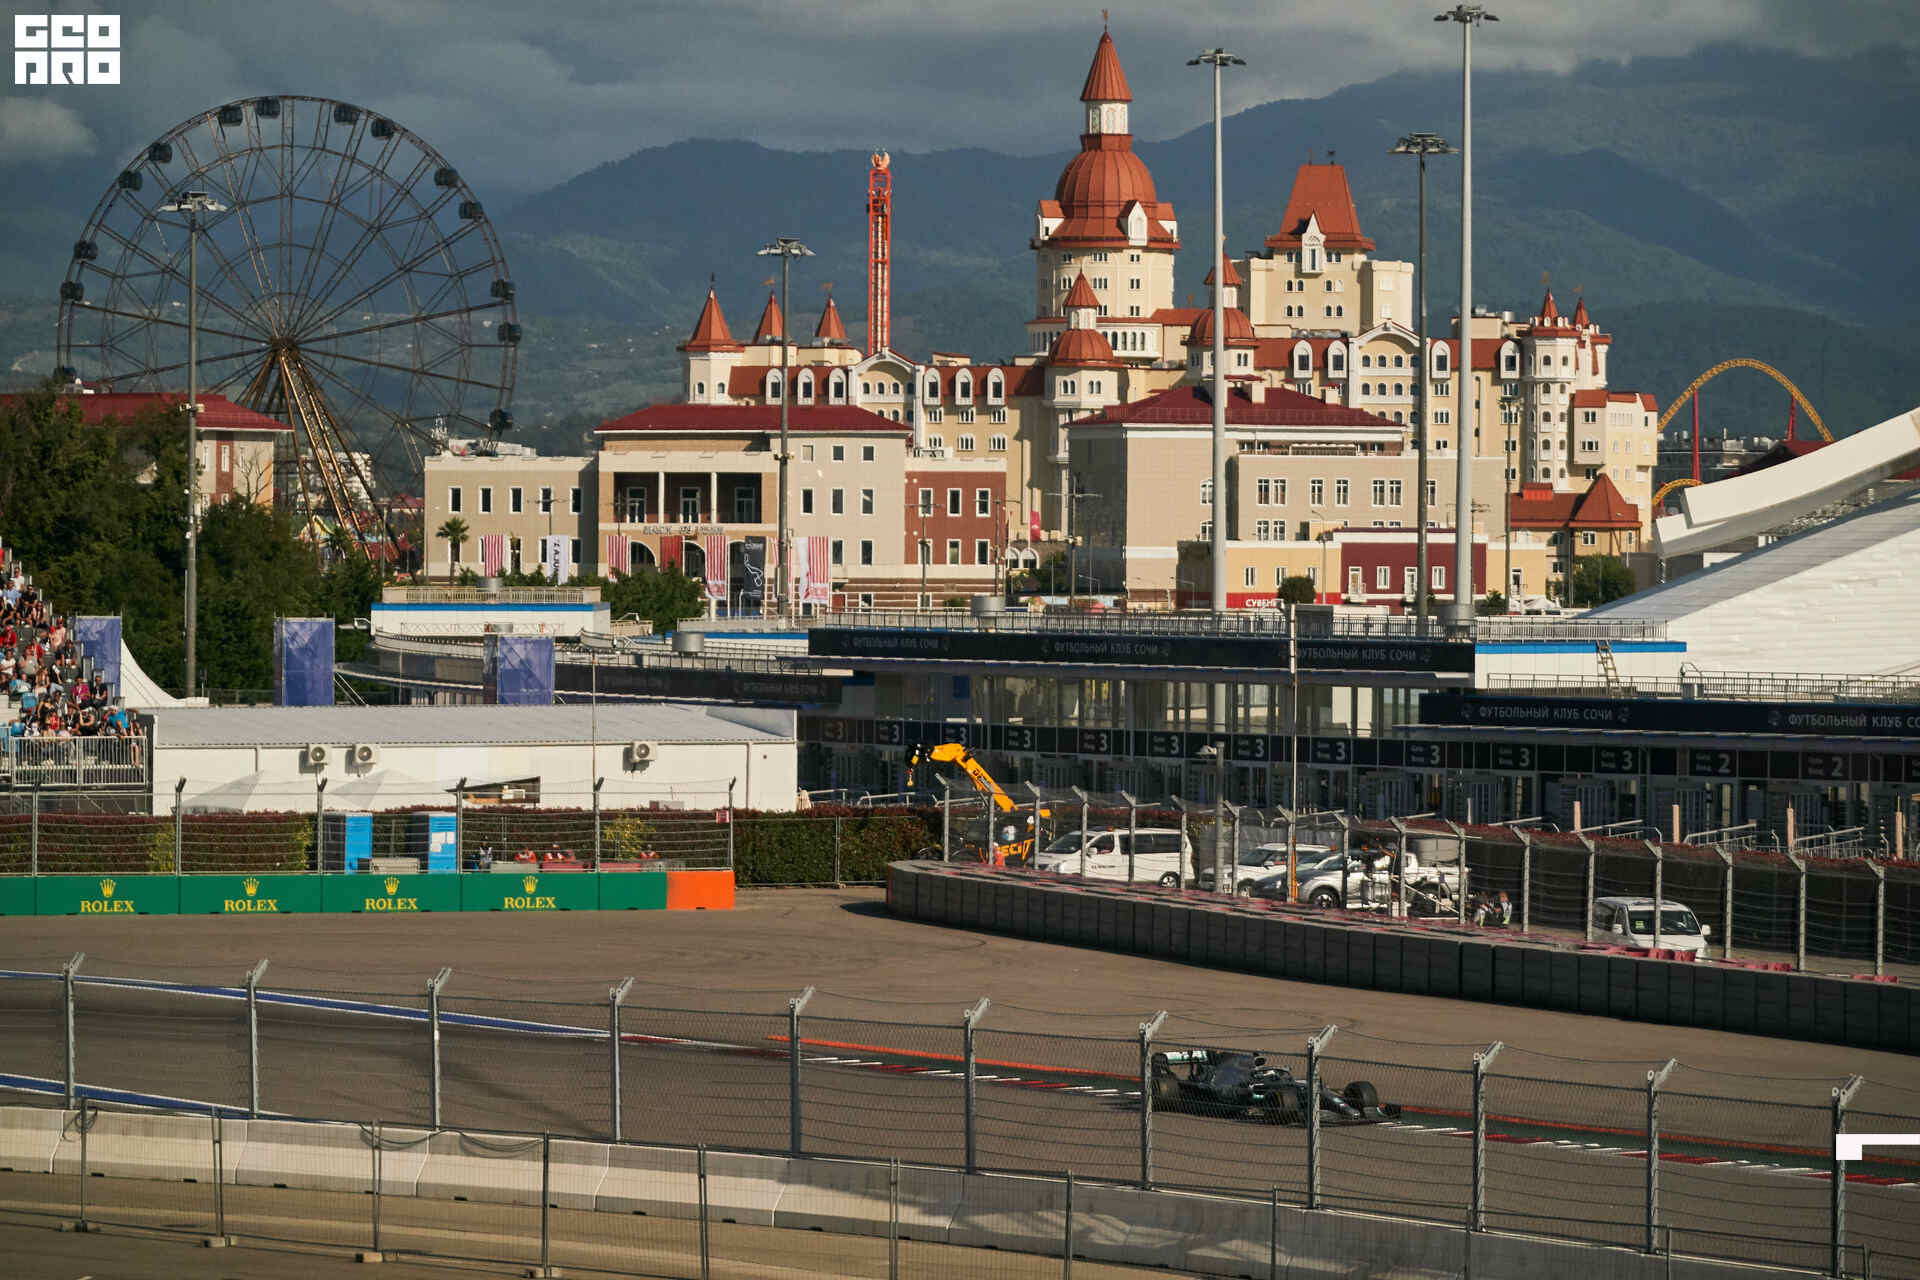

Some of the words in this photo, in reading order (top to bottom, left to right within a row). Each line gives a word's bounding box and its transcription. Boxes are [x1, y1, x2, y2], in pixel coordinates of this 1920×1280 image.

[1245, 598, 1273, 607] СУВЕН
[1480, 705, 1549, 719] ФУТБОЛЬНЫЙ
[1553, 707, 1581, 719] КЛУБ
[1583, 708, 1612, 720] СОЧИ
[1788, 713, 1867, 727] ФУТБОЛЬНЫЙ
[1872, 716, 1902, 728] КЛУБ
[1023, 730, 1031, 748] 3
[1099, 733, 1108, 751] 3
[1170, 735, 1179, 754] 3
[1255, 739, 1265, 757] 3
[1336, 741, 1345, 760] 3
[1430, 745, 1440, 764] 3
[1519, 748, 1530, 767] 3
[1621, 751, 1632, 769] 3
[1718, 754, 1730, 773] 2
[1831, 757, 1843, 776] 2
[81, 900, 135, 912] ROLEX
[224, 900, 278, 912] ROLEX
[365, 898, 419, 910] ROLEX
[504, 897, 556, 909] ROLEX
